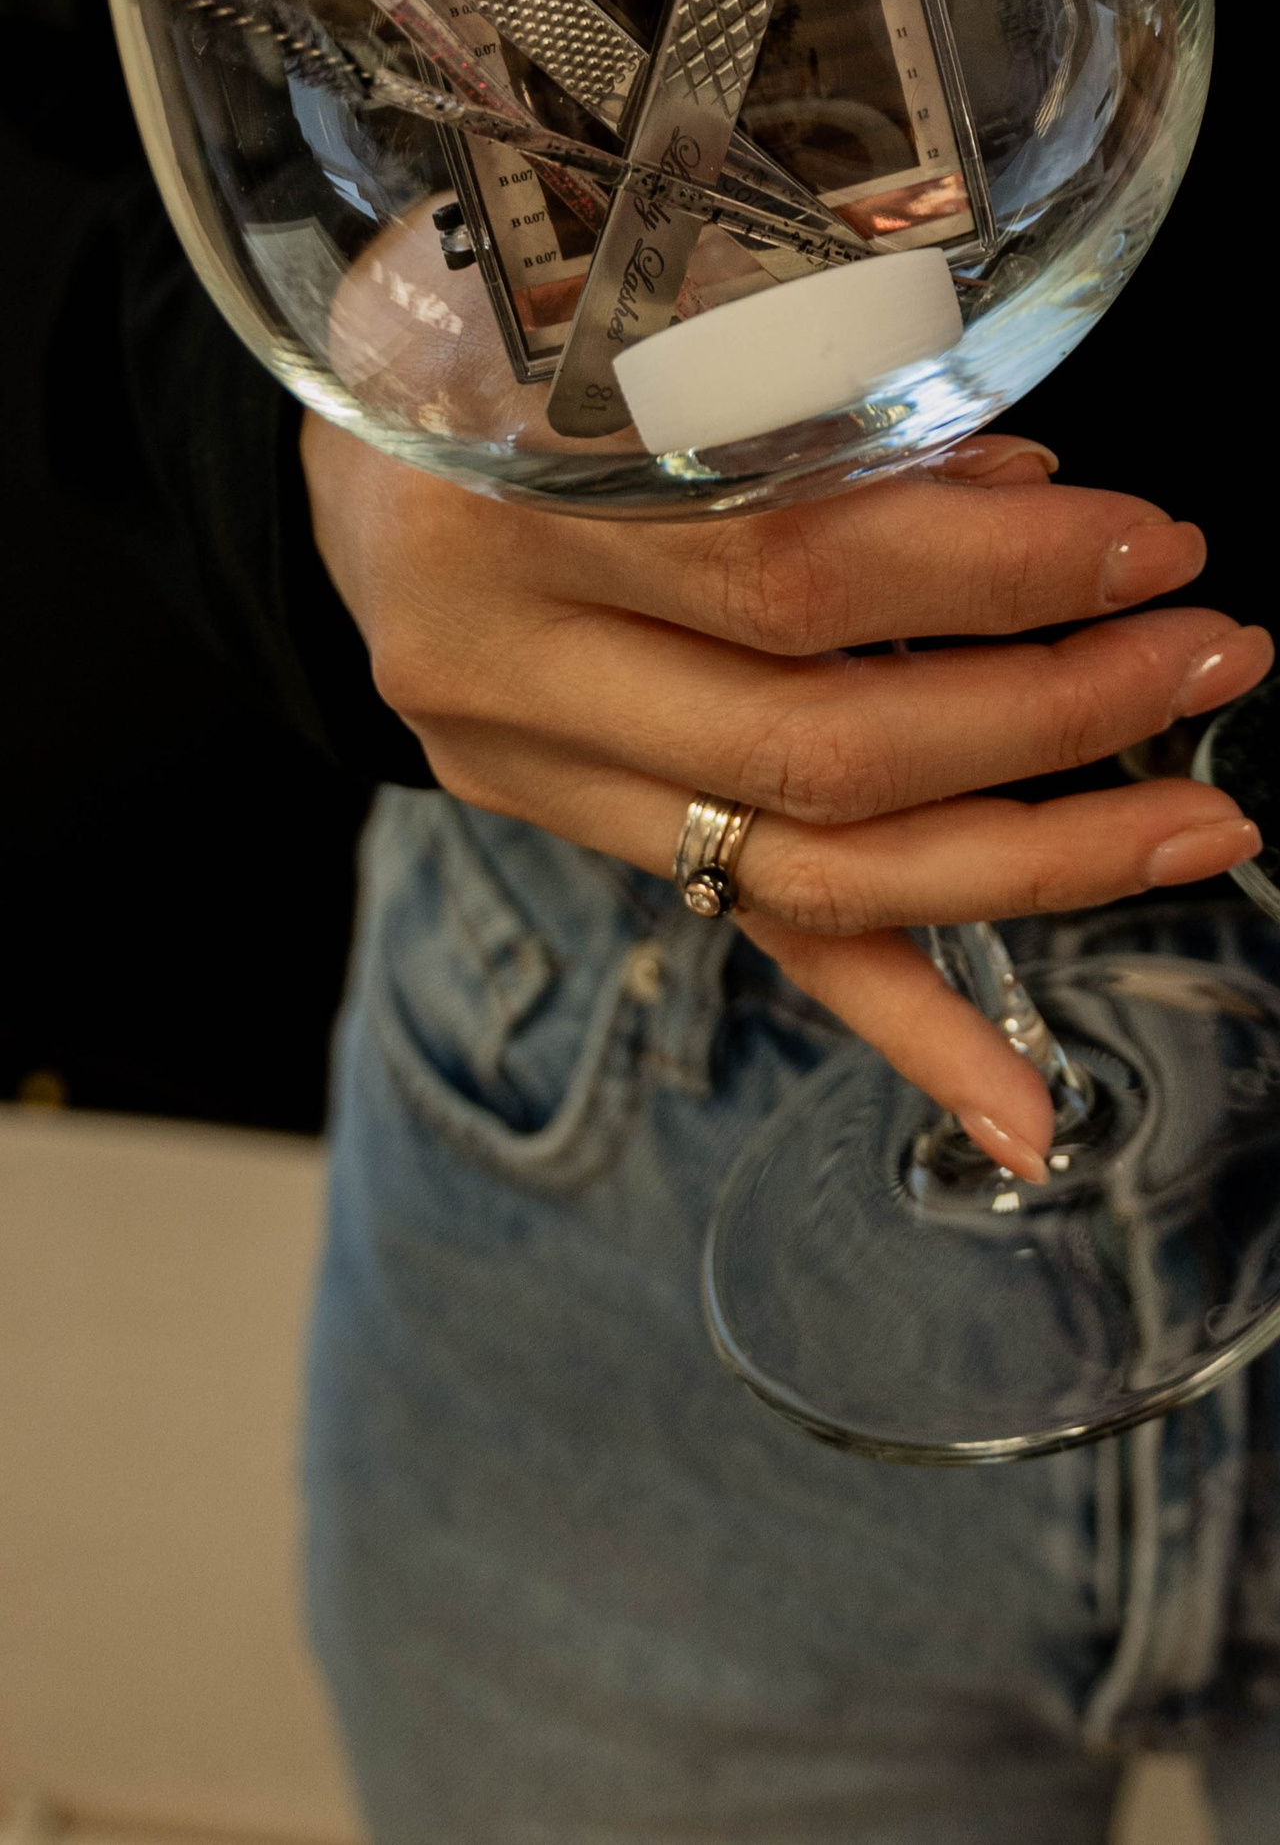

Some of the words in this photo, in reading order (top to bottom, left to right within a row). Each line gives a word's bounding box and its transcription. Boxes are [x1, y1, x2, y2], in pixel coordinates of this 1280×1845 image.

[449, 6, 460, 18] B
[896, 26, 908, 38] 11
[474, 42, 497, 58] 0.07
[906, 67, 919, 79] 11
[916, 107, 930, 120] 12
[926, 147, 940, 160] 12
[498, 175, 510, 188] B
[511, 169, 533, 185] 0.07
[633, 125, 700, 231] Loly
[511, 217, 522, 229] B
[523, 210, 545, 226] 0.07
[523, 256, 534, 269] B
[535, 250, 557, 266] 0.07
[606, 237, 665, 344] Lashes
